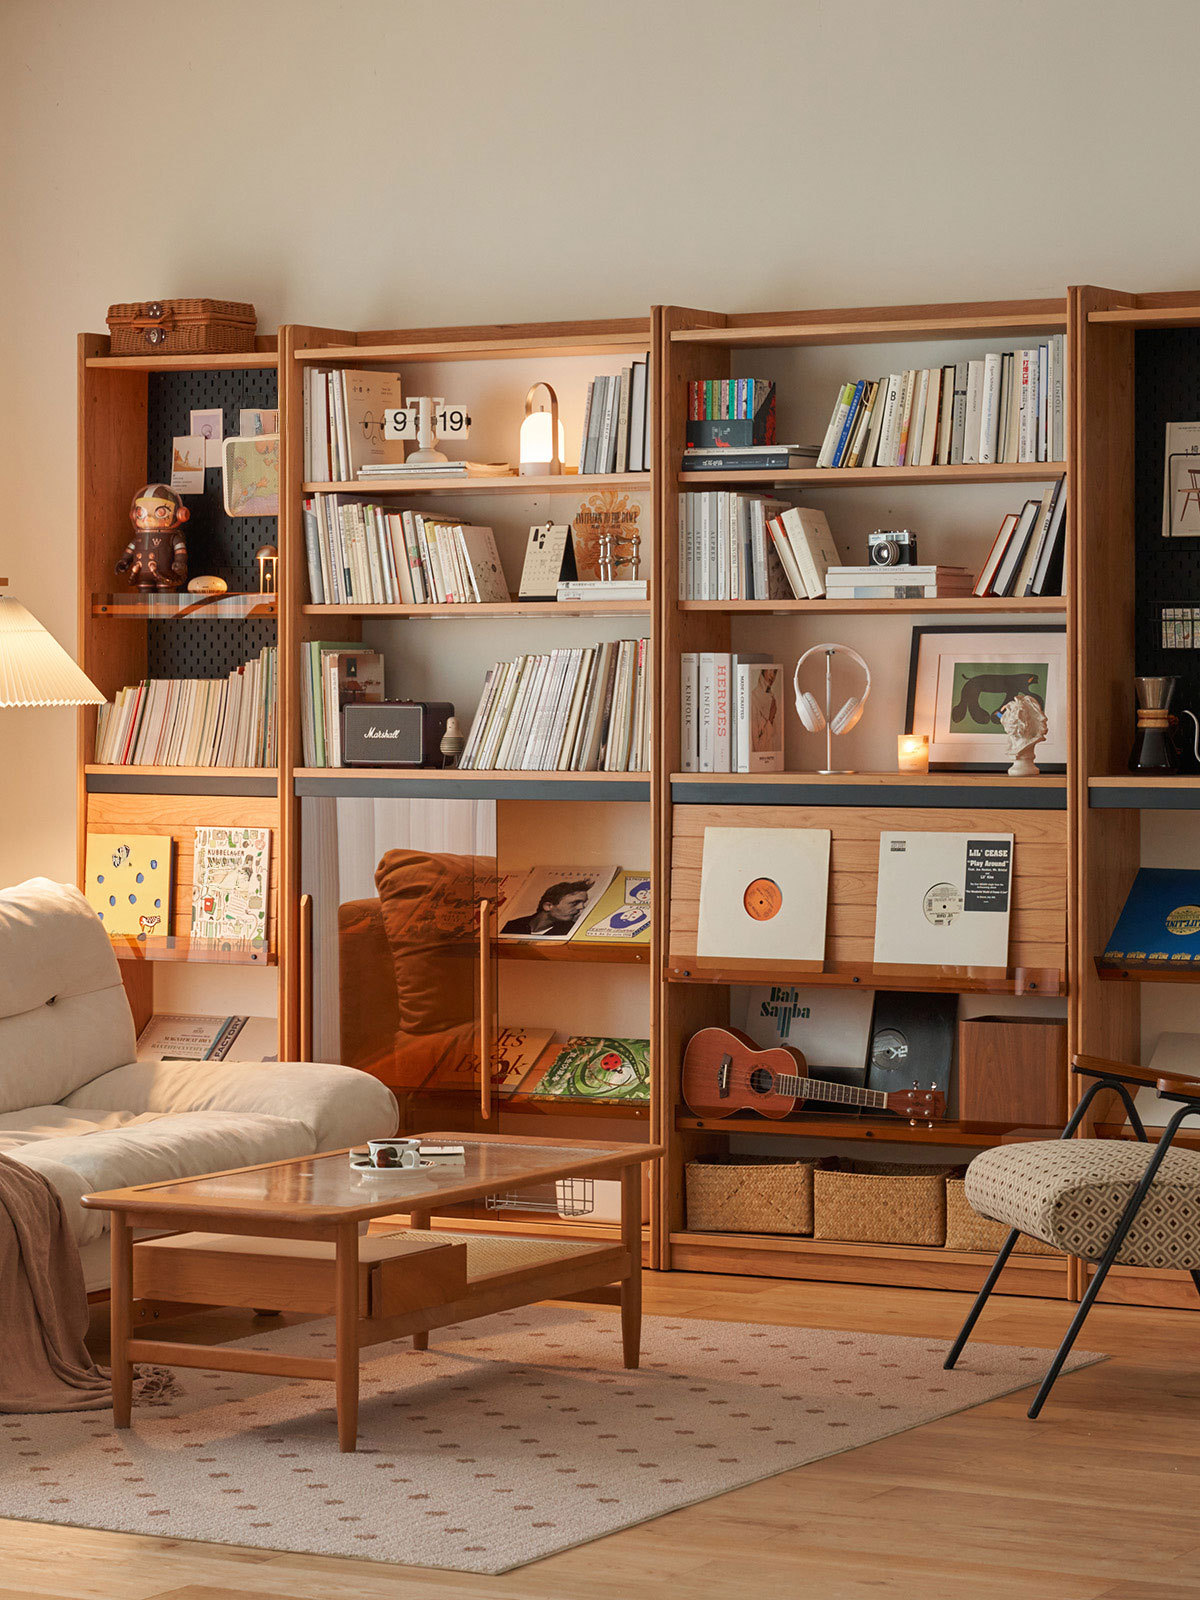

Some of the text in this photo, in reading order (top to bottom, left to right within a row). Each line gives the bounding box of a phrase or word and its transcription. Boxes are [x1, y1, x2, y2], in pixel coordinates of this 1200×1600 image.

[393, 411, 464, 432] 9 19
[717, 665, 727, 737] HERMES
[364, 726, 401, 739] Marshall
[984, 849, 1008, 857] CEASE
[770, 986, 799, 1002] Bah
[215, 1017, 241, 1058] FACTORY
[497, 1028, 527, 1047] It's
